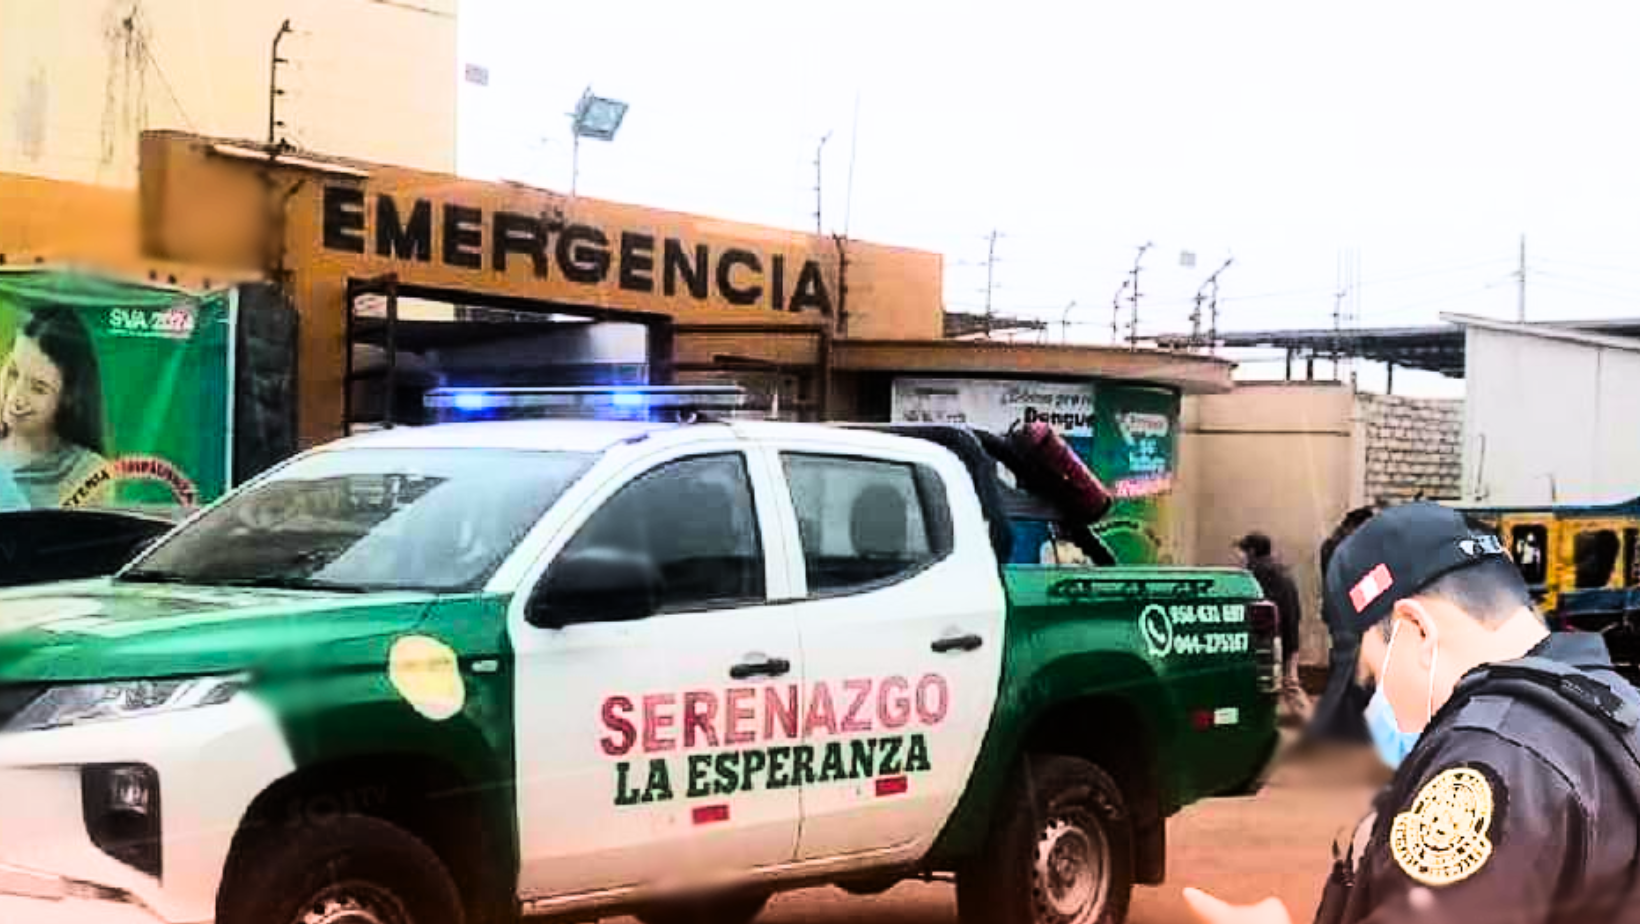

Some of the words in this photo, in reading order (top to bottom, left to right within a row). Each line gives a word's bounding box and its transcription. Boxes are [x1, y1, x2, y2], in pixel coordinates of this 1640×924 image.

[322, 184, 834, 317] EMERGENCIA
[600, 673, 949, 756] SERENAZGO
[613, 758, 674, 806] LA
[686, 733, 932, 799] ESPERANZA
